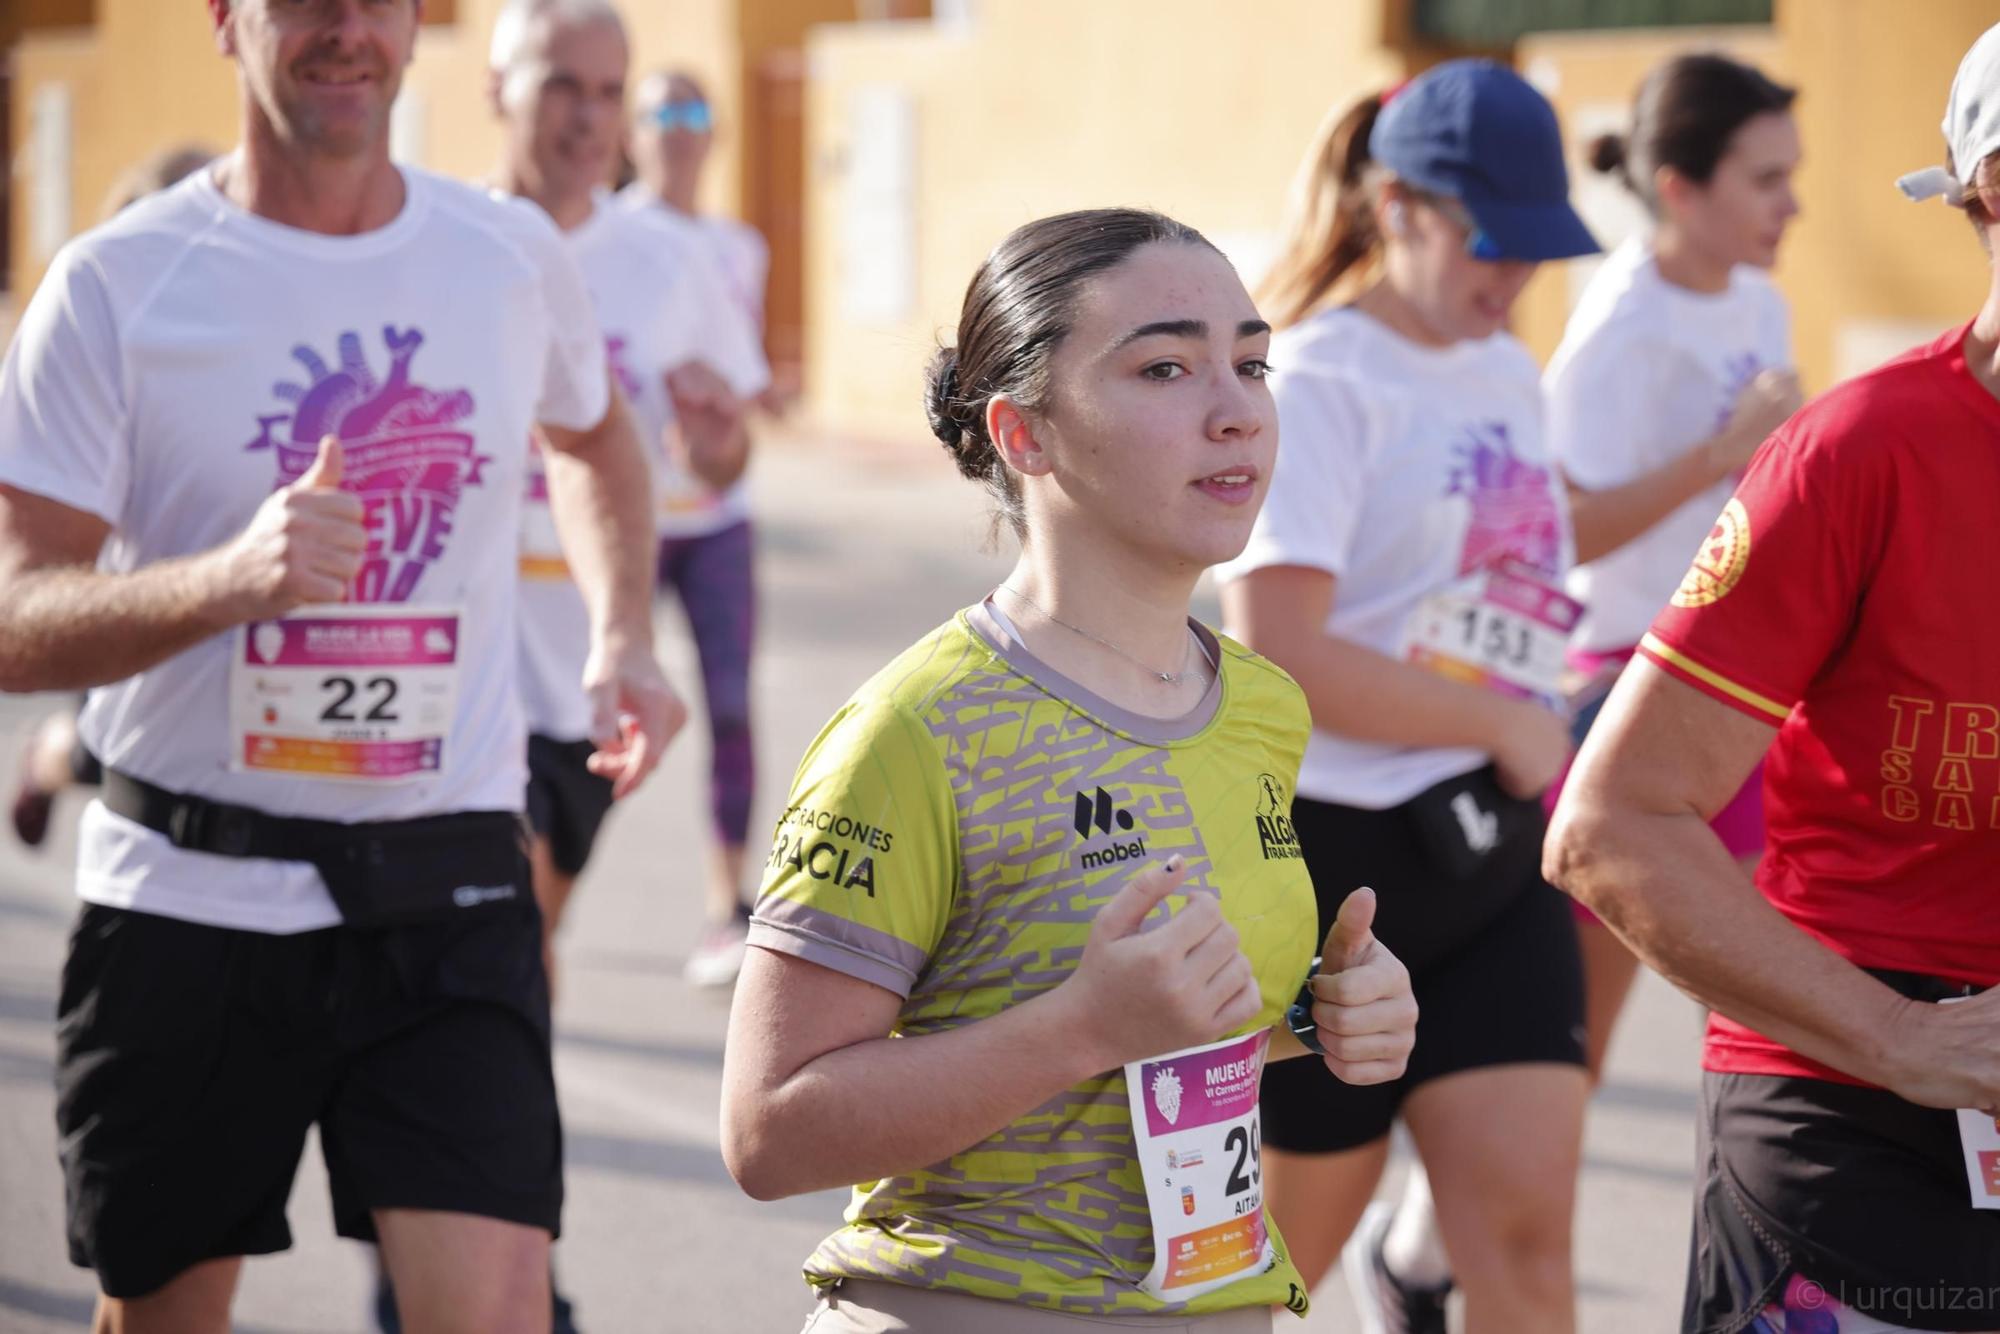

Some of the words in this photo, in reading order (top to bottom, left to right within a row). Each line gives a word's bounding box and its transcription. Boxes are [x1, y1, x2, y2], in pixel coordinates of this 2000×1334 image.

[320, 676, 398, 721] 22
[1880, 749, 2000, 793] SA
[1881, 784, 2000, 830] CA
[766, 834, 875, 898] RACIA
[1081, 837, 1146, 869] mobel
[1205, 1060, 1246, 1086] MUEVE
[1224, 1117, 1260, 1197] 29
[1165, 1178, 1171, 1187] S
